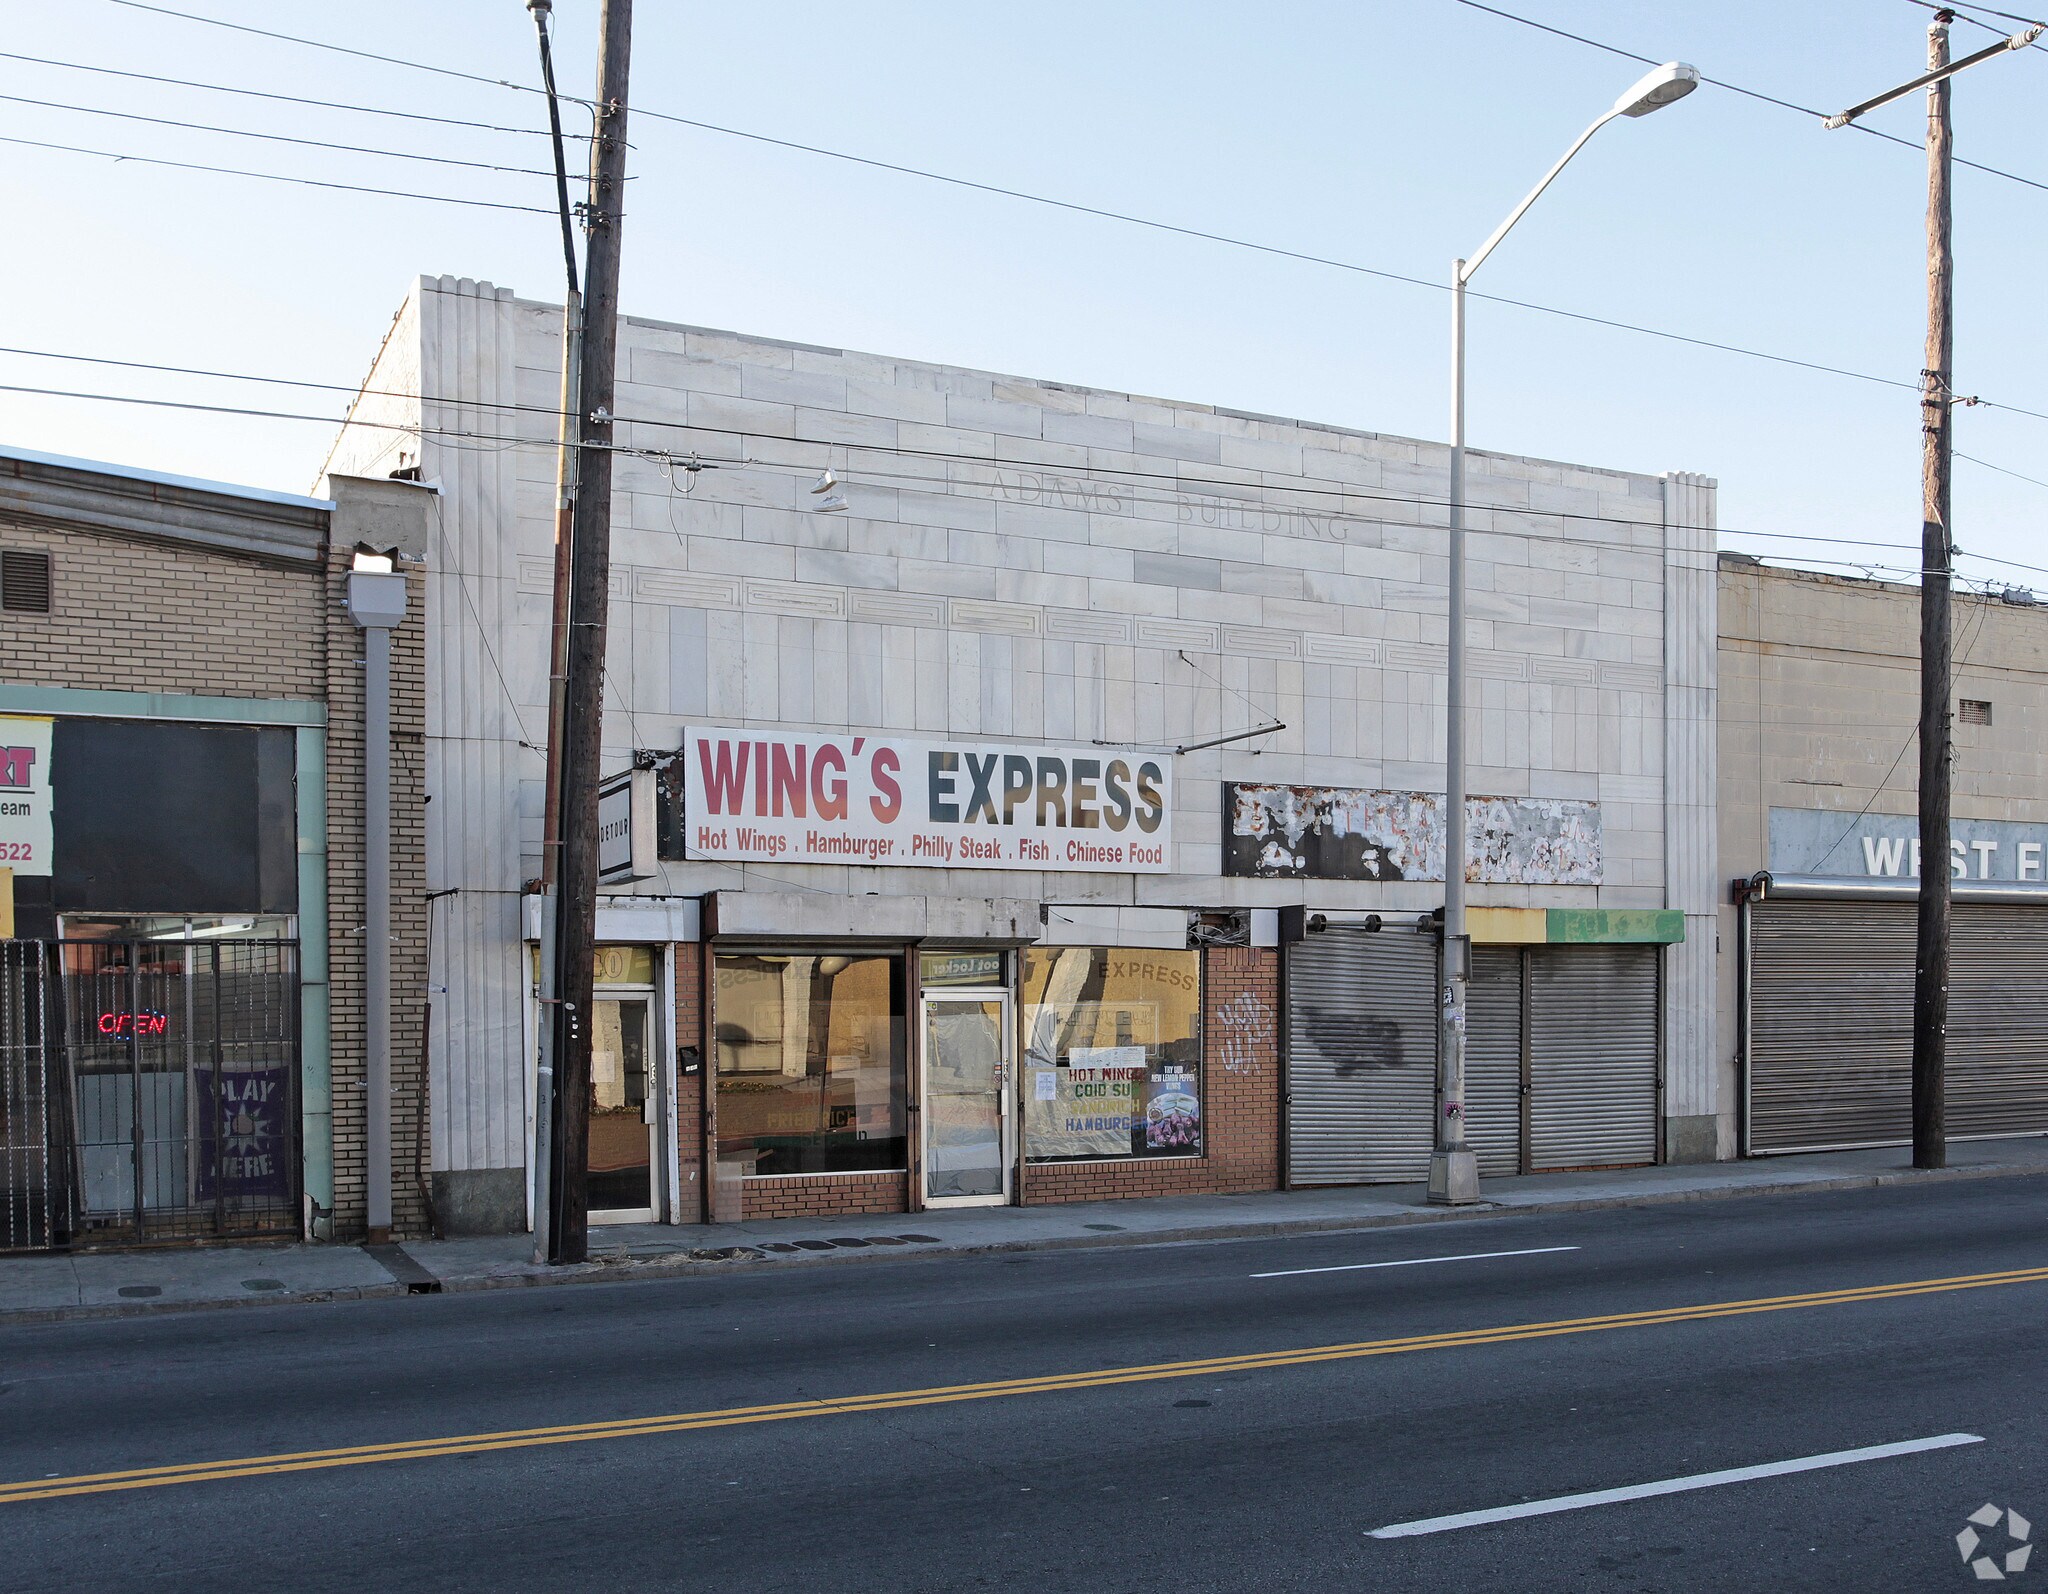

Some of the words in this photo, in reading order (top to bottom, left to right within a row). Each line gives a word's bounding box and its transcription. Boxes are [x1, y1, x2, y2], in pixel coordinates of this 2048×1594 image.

[989, 470, 1124, 513] ADAMS
[1176, 494, 1349, 543] BUILDING
[697, 737, 902, 825] WING'S
[928, 750, 1163, 834] EXPRESS
[600, 818, 628, 843] DETOUR
[698, 826, 727, 850] Hot
[736, 828, 787, 857] Wings
[806, 830, 894, 860] Hamburger
[912, 834, 953, 861] Philly
[959, 835, 1001, 859] Steak
[1019, 838, 1049, 861] Fish
[1066, 839, 1122, 863] Chinese
[1129, 842, 1162, 864] Food
[1099, 961, 1194, 991] EXPRESS
[98, 1013, 167, 1034] OPEN
[1069, 1067, 1095, 1083] HOT
[209, 1079, 276, 1102] PLAY
